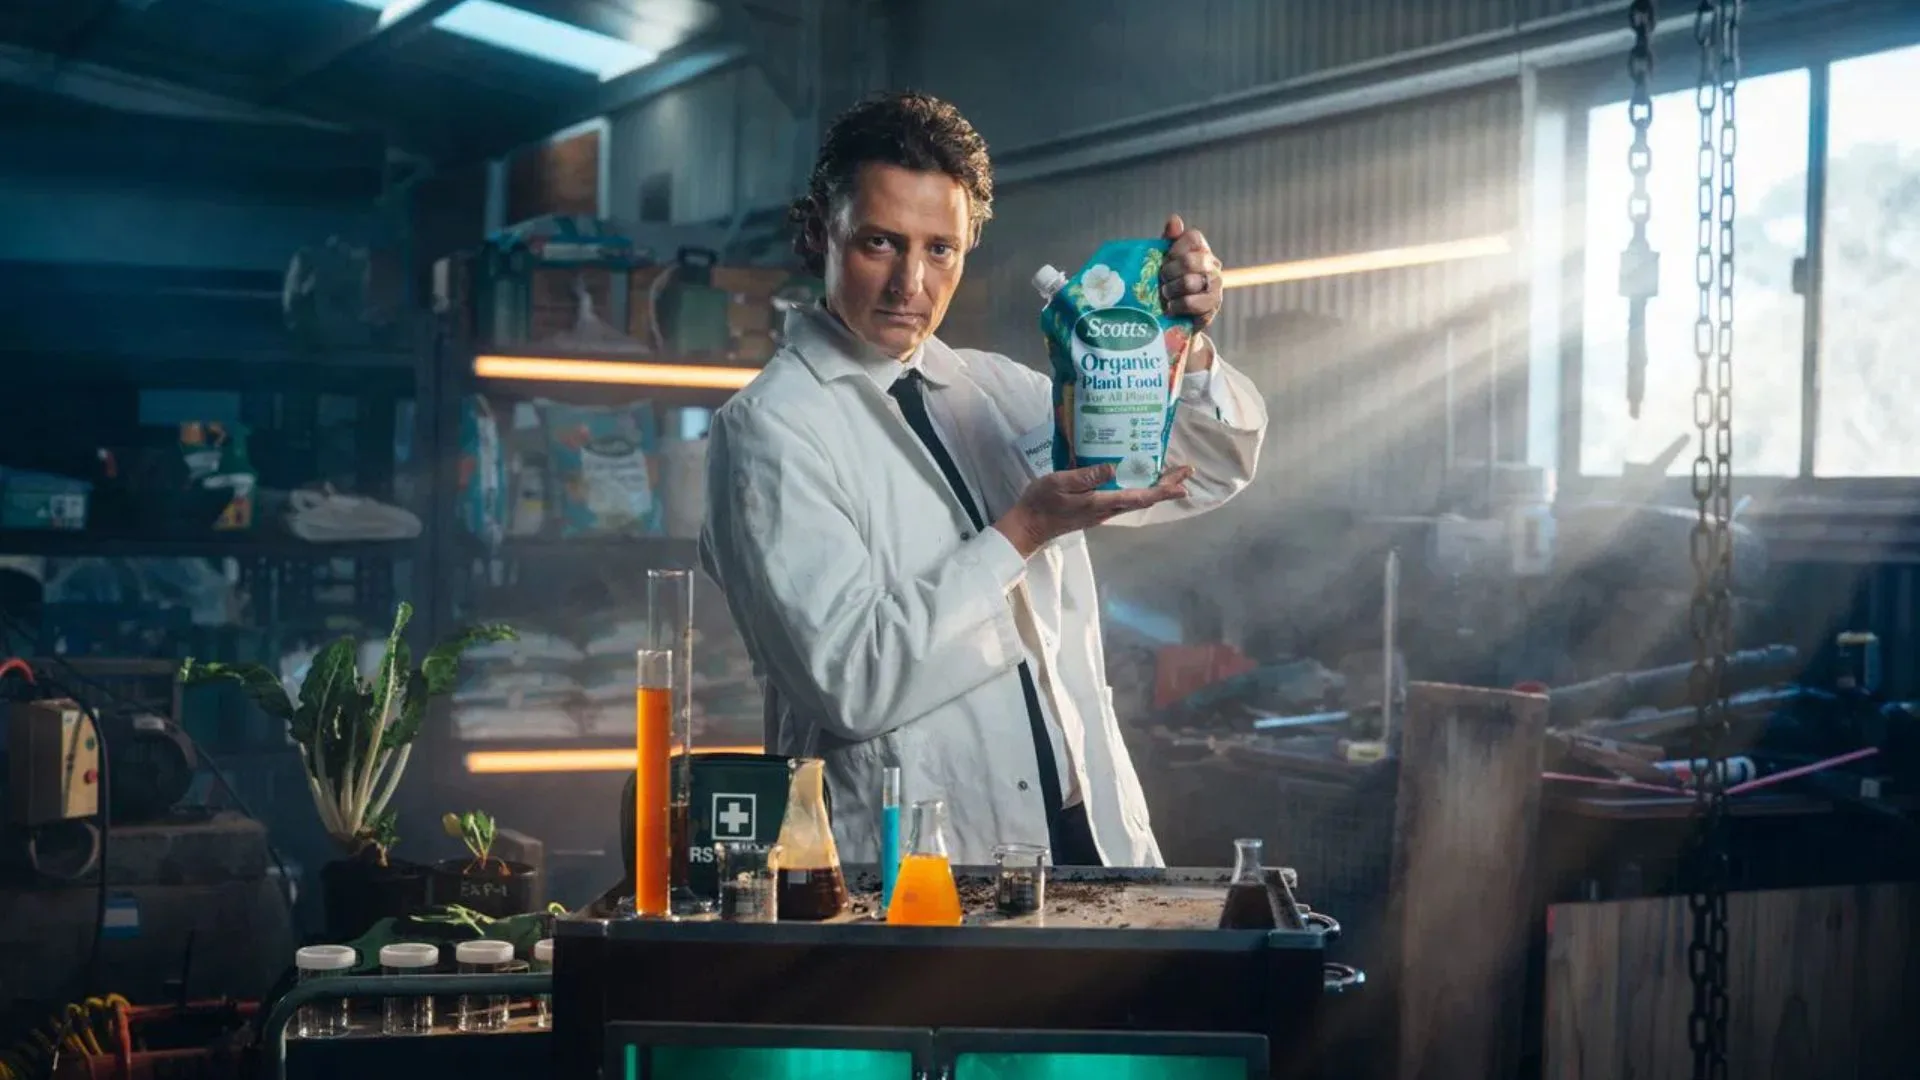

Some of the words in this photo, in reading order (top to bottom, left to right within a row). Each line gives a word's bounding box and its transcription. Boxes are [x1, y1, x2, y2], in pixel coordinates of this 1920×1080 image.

[1086, 318, 1148, 338] Scotts
[1081, 352, 1160, 375] Organic
[1082, 375, 1122, 389] Plant
[1127, 373, 1162, 388] Food
